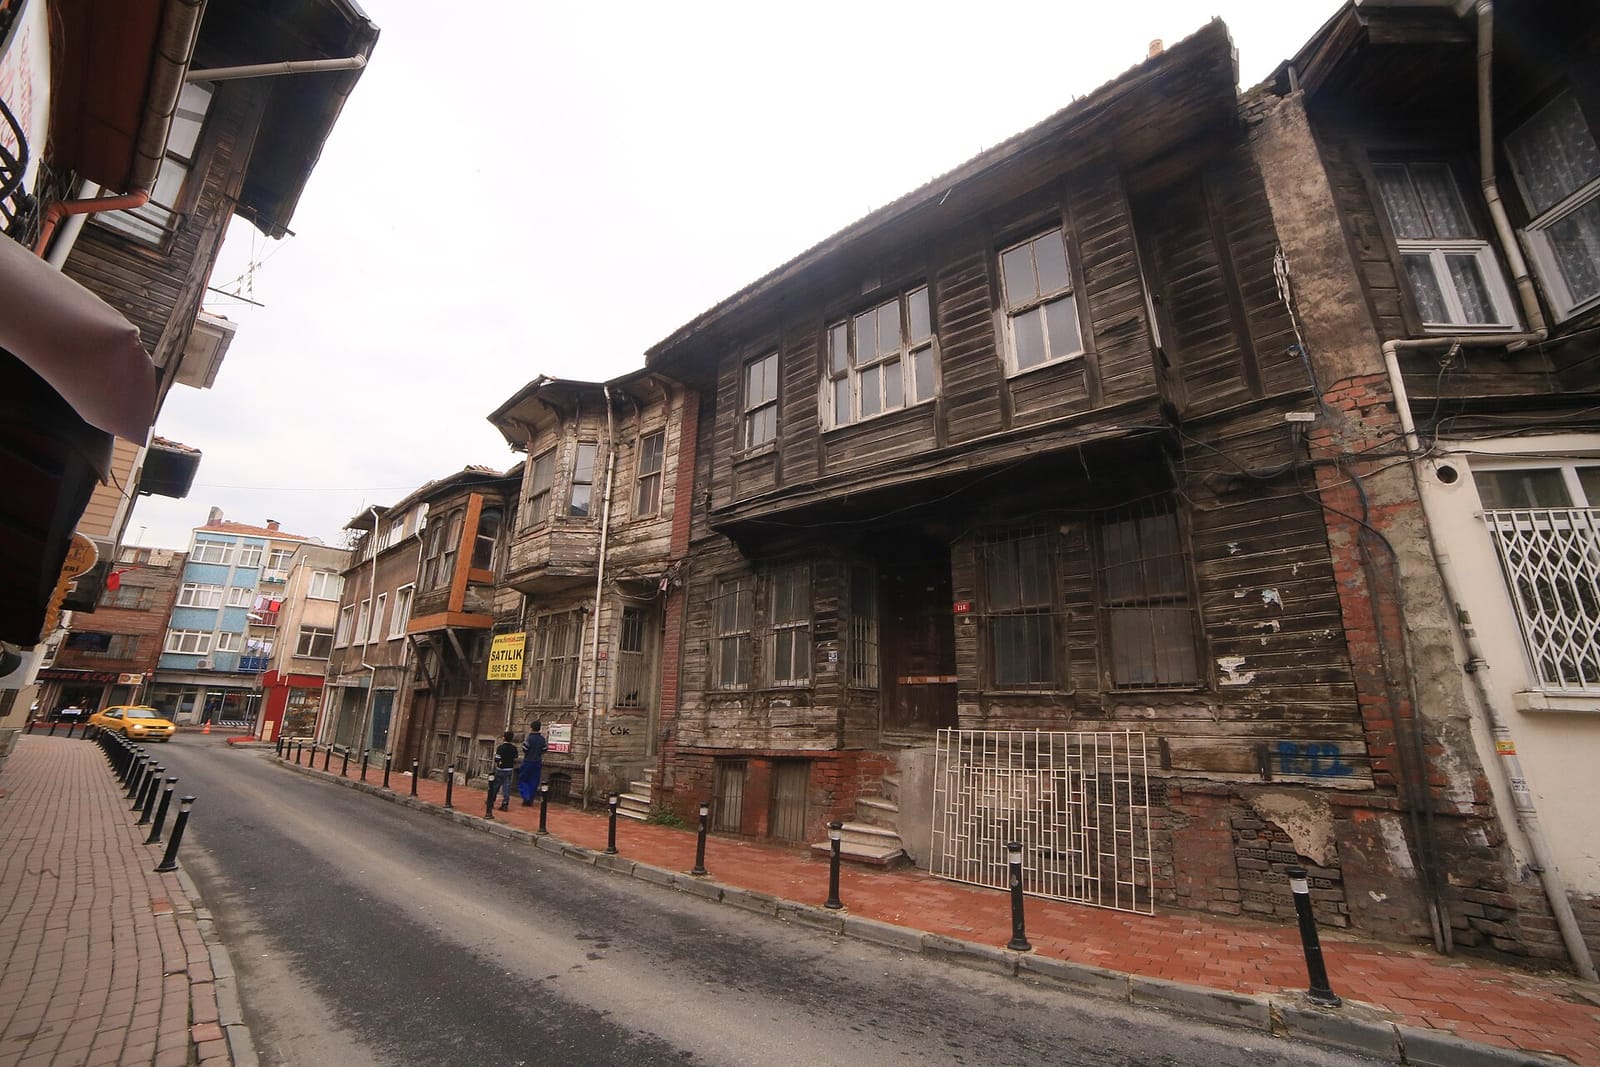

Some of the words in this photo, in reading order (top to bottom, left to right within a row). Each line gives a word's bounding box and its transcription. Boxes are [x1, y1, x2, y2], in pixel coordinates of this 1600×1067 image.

[491, 649, 523, 661] SATILIK
[491, 664, 501, 672] 505
[502, 664, 509, 672] 12
[509, 664, 518, 672] 55
